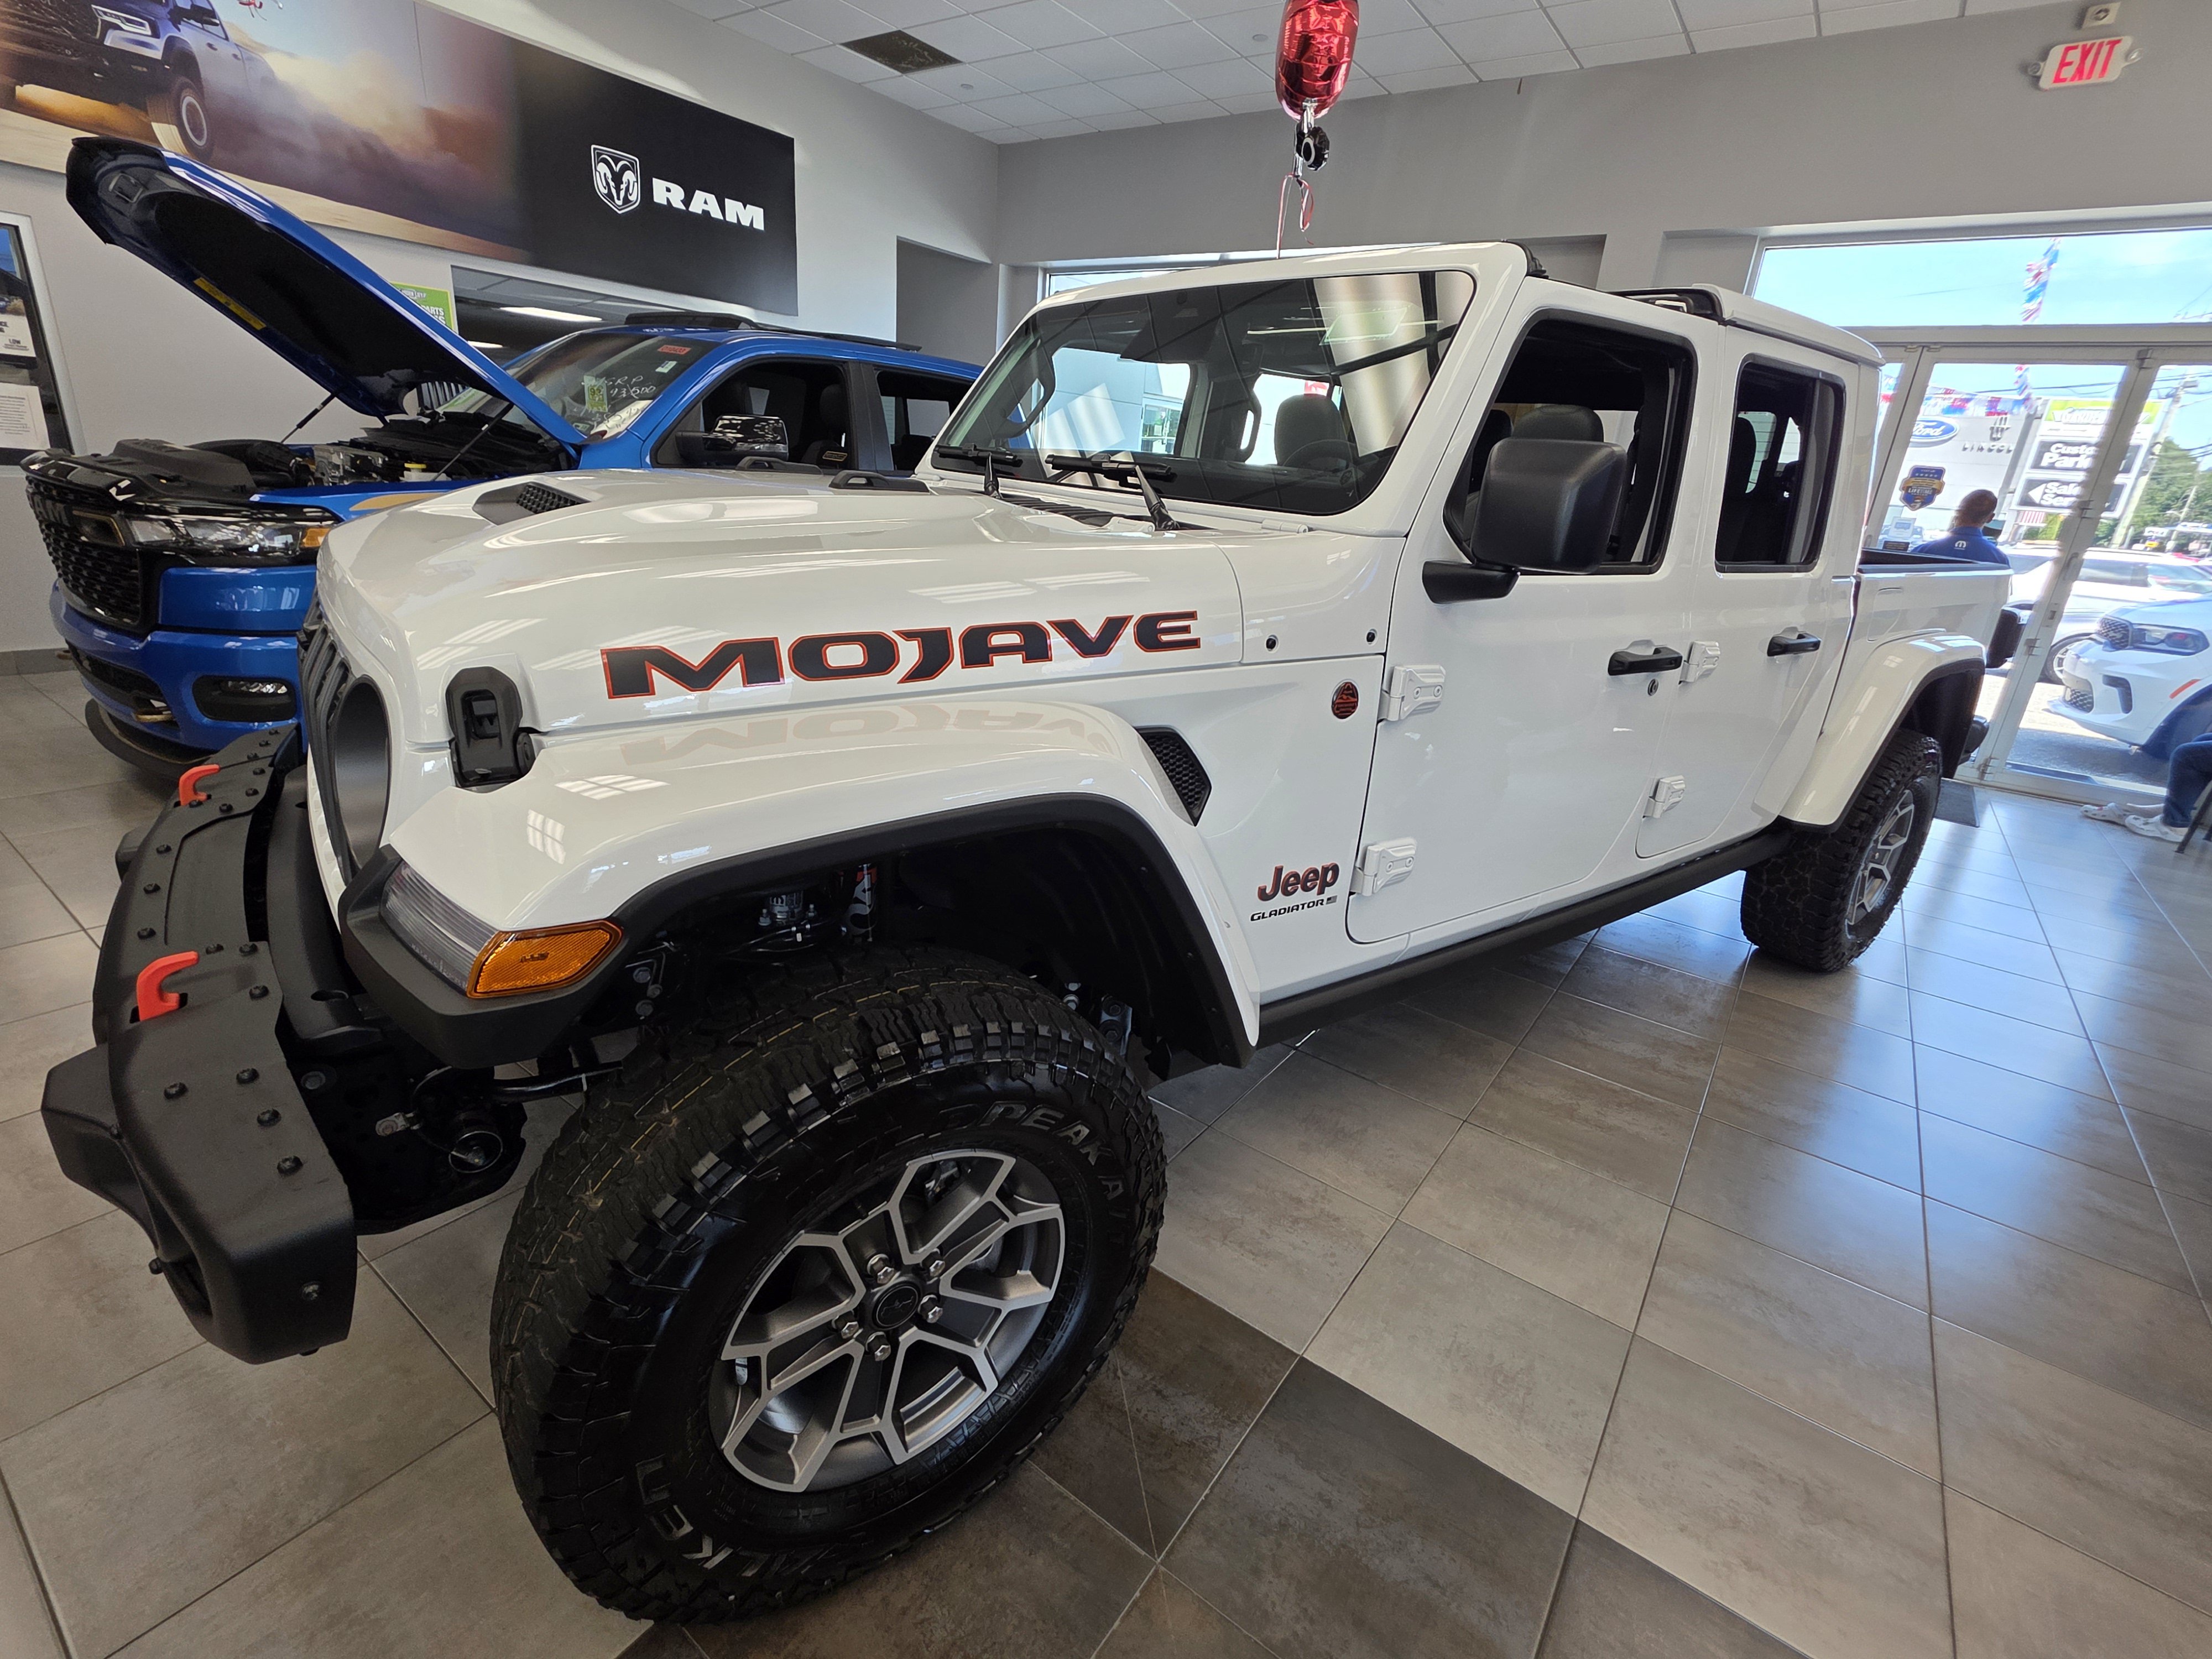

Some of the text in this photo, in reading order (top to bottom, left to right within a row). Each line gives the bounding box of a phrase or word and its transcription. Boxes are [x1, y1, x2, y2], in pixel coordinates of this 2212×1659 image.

[2052, 38, 2124, 84] EXIT
[652, 177, 765, 231] RAM
[1961, 442, 2014, 454] LINCOL
[2051, 443, 2098, 455] Custo
[2041, 452, 2093, 468] Park
[2044, 482, 2082, 495] Sale
[600, 611, 1201, 700] MOJAVE
[1258, 862, 1340, 901] Jeep
[1250, 899, 1324, 921] GLADIATOR
